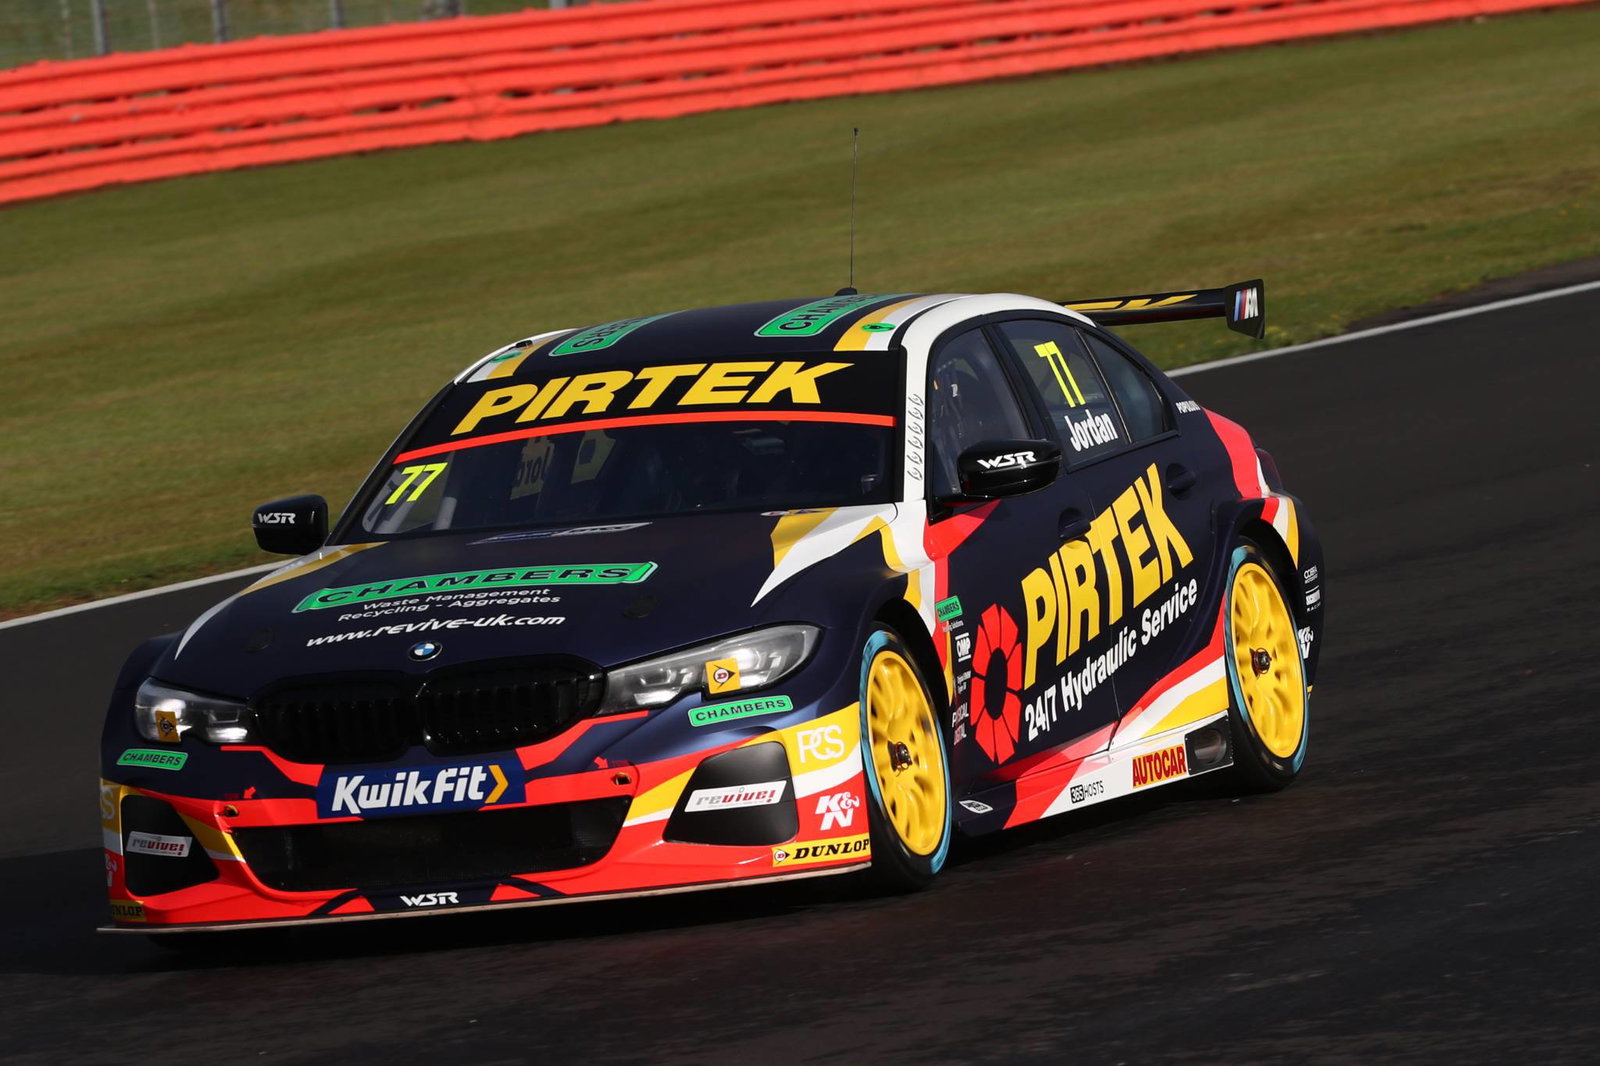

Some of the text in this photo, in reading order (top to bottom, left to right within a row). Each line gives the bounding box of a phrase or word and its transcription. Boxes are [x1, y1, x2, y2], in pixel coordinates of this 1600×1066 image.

[1034, 341, 1086, 408] 77
[452, 361, 855, 436] PIRTEK
[1064, 408, 1119, 452] Jordan
[977, 451, 1037, 470] WSR
[384, 462, 449, 506] 77
[257, 512, 297, 524] WSR
[317, 567, 632, 604] CHAMBERS
[1021, 463, 1194, 691] PIRTEK
[338, 604, 430, 622] Recycling
[449, 596, 561, 608] Aggregates
[363, 588, 551, 611] Waste Management
[306, 614, 566, 647] www.revive-uk.com
[1025, 578, 1198, 742] 24/7 Hydraulic Service
[695, 700, 787, 722] CHAMBERS
[122, 753, 182, 766] CHAMBERS
[1132, 746, 1187, 788] AUTOCAR
[696, 790, 776, 806] revive!
[131, 837, 185, 856] revive!
[793, 839, 870, 860] DUNLOP
[400, 891, 460, 907] WSR
